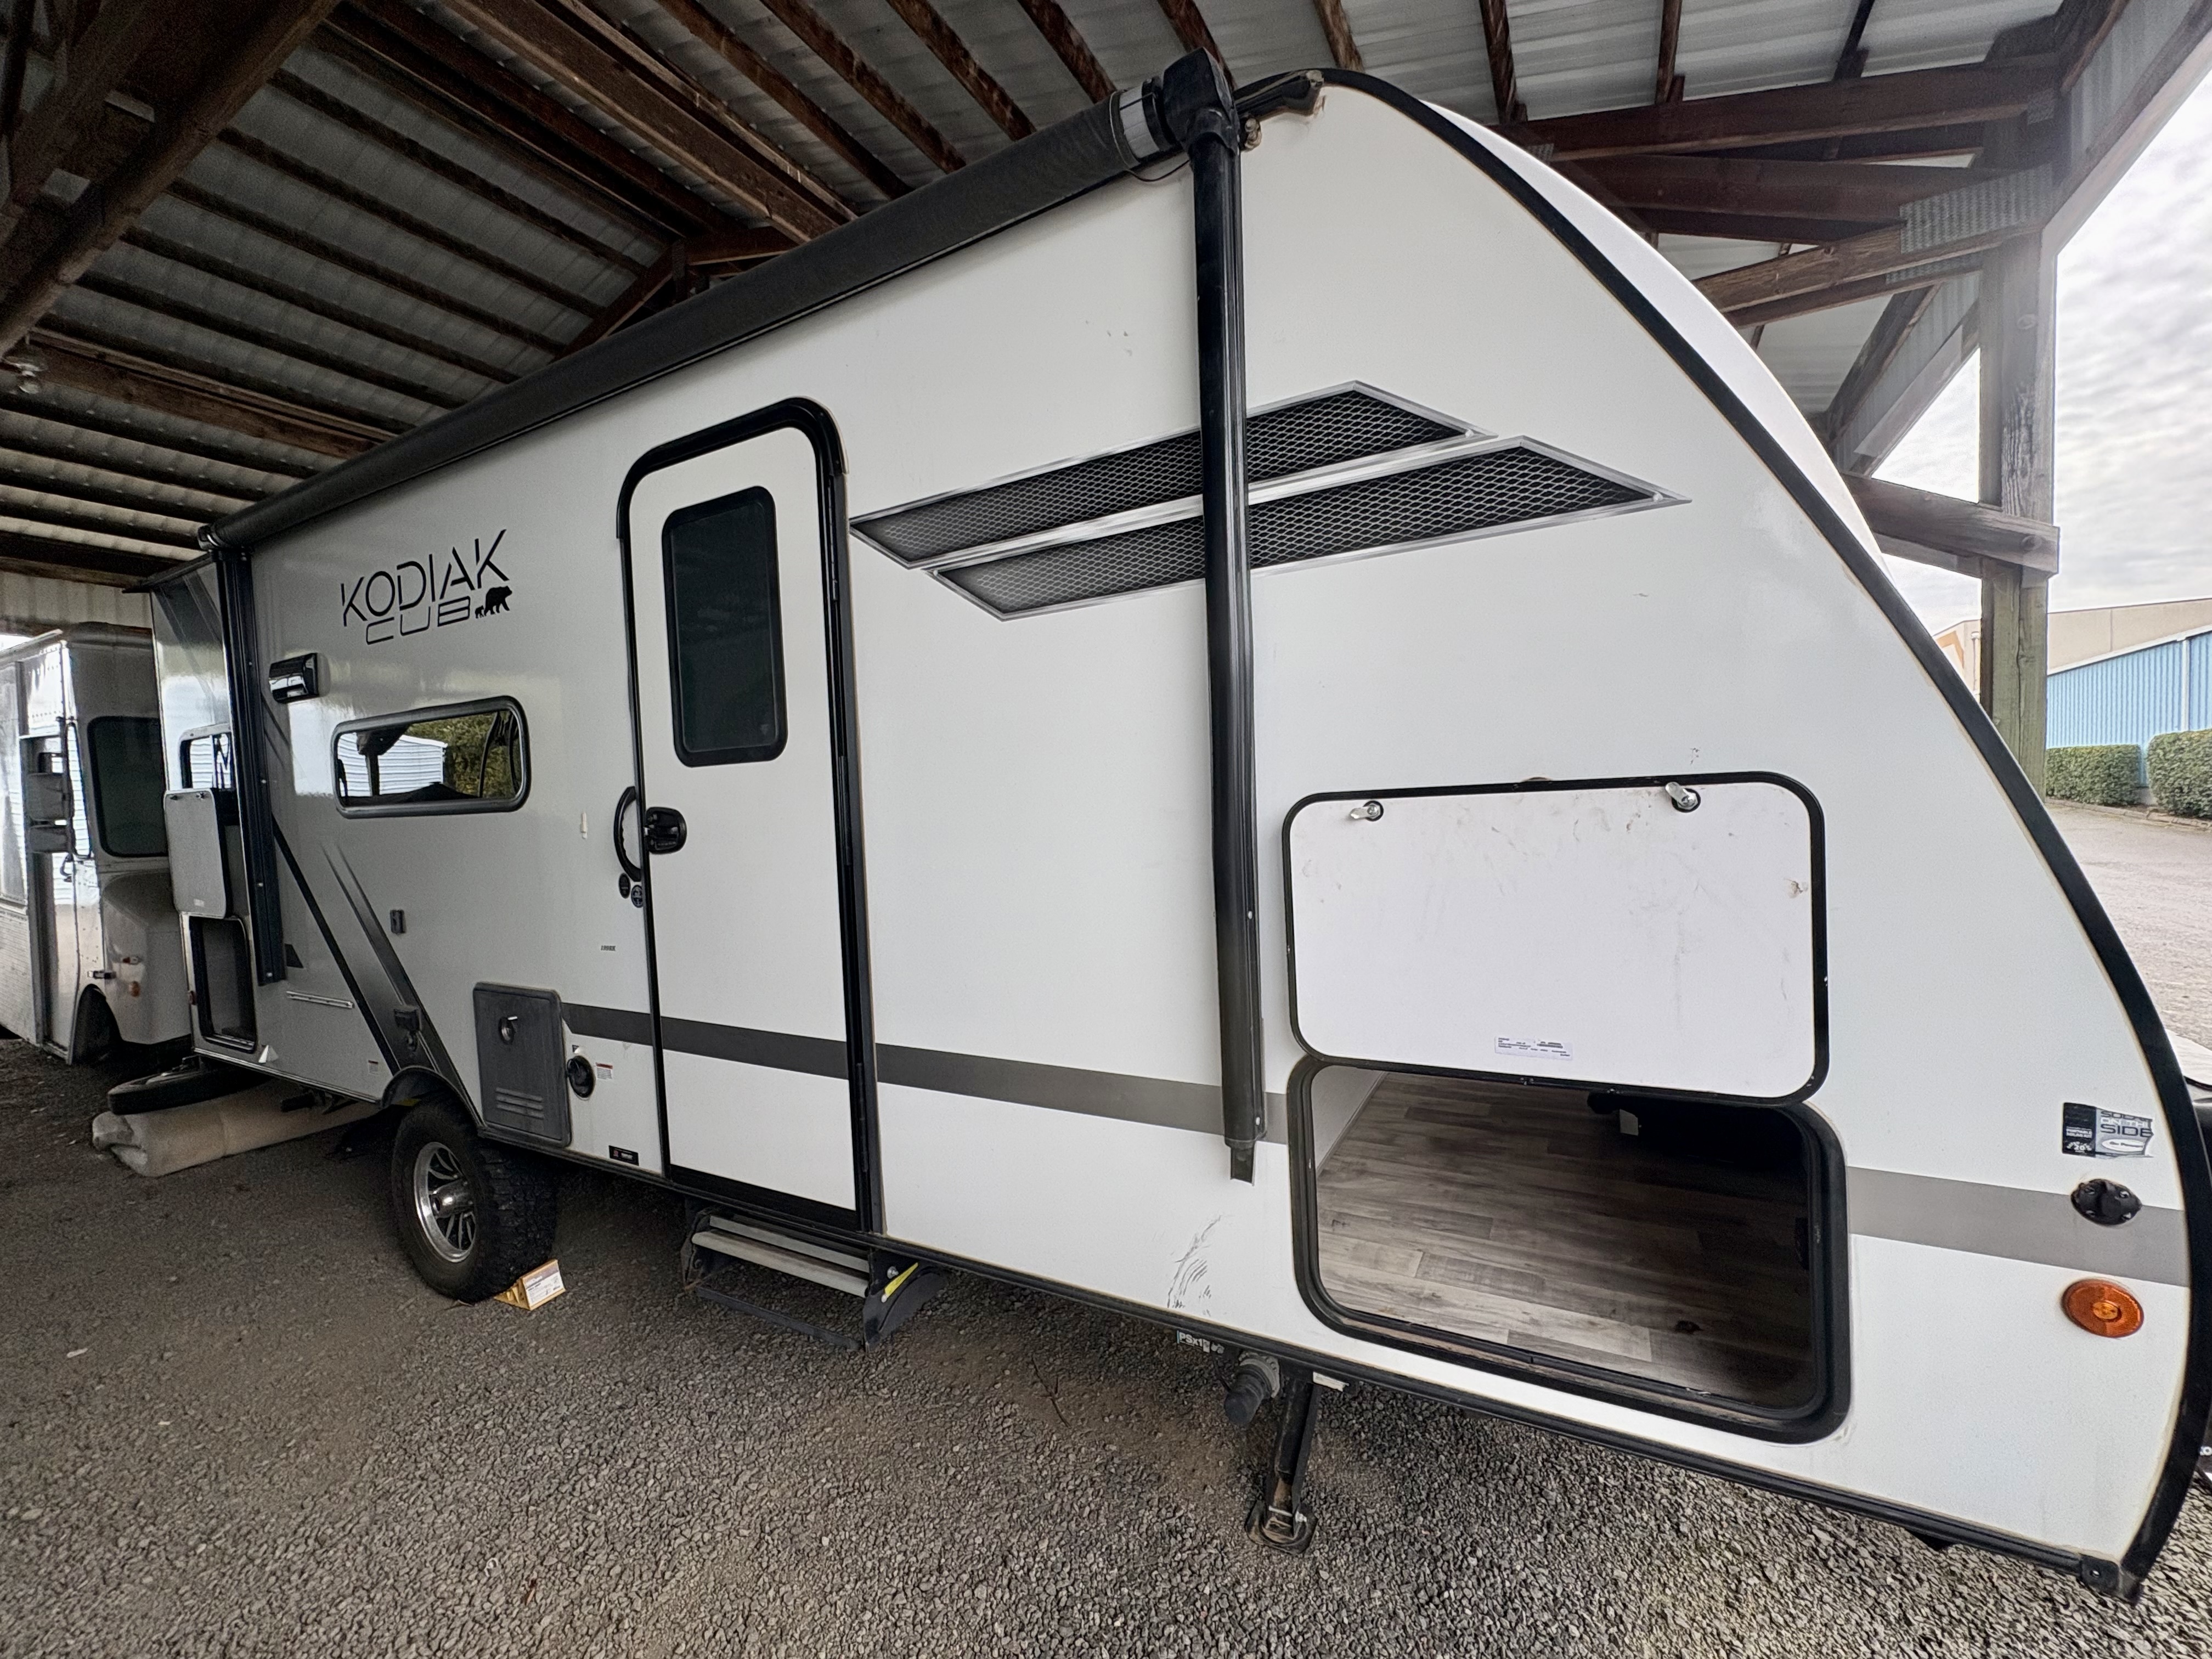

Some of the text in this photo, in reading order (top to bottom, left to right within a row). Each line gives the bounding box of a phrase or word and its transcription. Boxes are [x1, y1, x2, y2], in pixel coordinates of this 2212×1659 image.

[341, 529, 510, 627] KODIAK
[366, 596, 470, 645] CUB
[2100, 1124, 2153, 1138] SIDE
